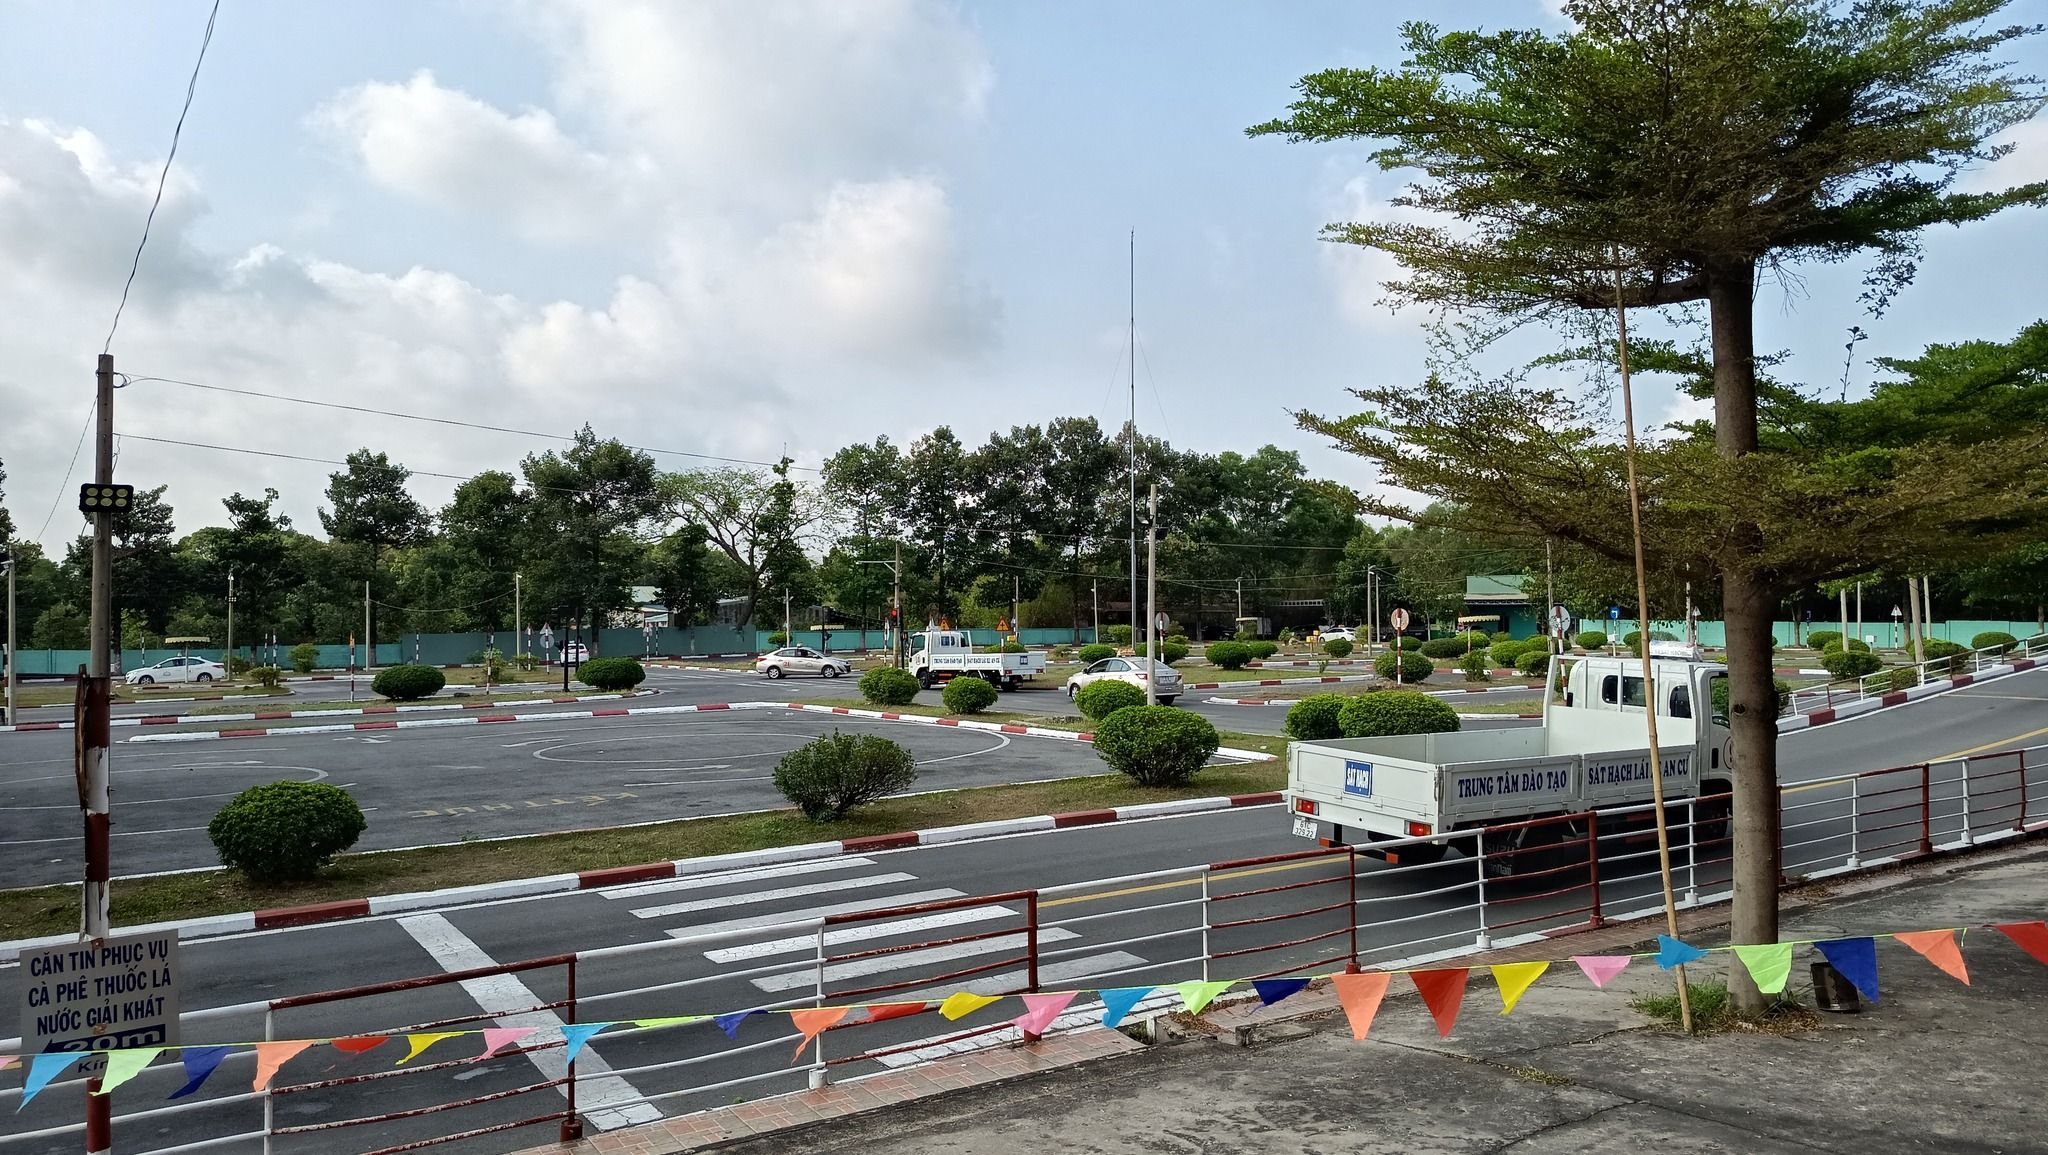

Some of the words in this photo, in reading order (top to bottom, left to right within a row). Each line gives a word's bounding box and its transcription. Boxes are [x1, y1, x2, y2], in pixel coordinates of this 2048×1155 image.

[1458, 777, 1493, 798] TRUNG
[1497, 771, 1519, 795] TÂM
[1522, 768, 1543, 792] ĐÀO
[1547, 770, 1567, 792] TẠO
[1588, 763, 1607, 785] SÁT
[1608, 764, 1632, 786] HẠCH
[1634, 758, 1649, 780] LÁI
[1664, 761, 1676, 777] AN
[31, 952, 64, 977] CĂN
[69, 950, 96, 971] TIN
[101, 944, 143, 968] PHỤC
[149, 939, 168, 961] VỤ
[29, 981, 50, 1007] CÀ
[56, 975, 88, 1004] PHÊ
[94, 964, 147, 996] THUỐC
[152, 963, 171, 988] LÁ
[37, 1007, 81, 1036] NƯỚC
[87, 999, 118, 1027] GIẢI
[124, 994, 165, 1021] KHÁT
